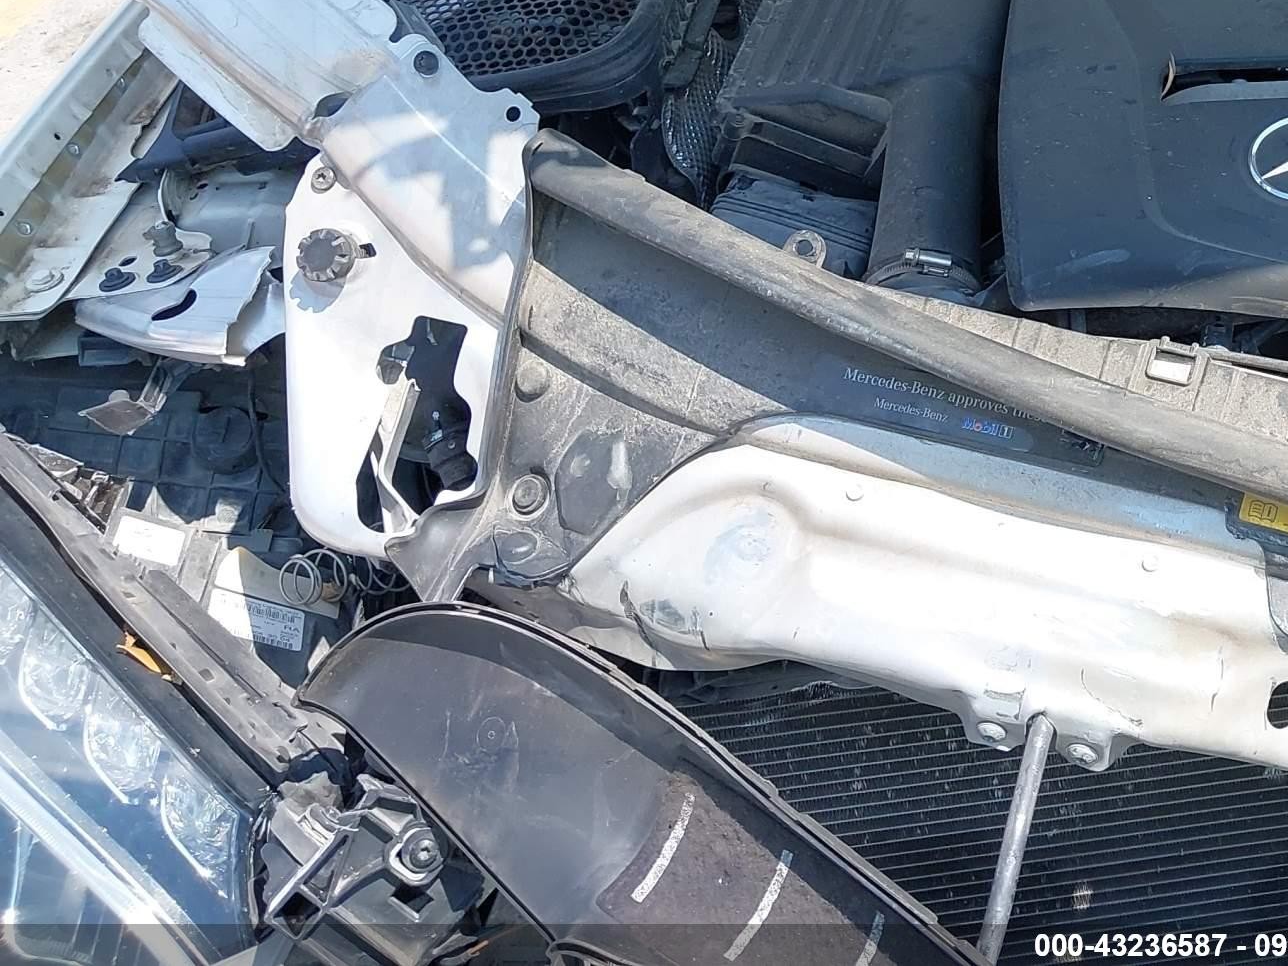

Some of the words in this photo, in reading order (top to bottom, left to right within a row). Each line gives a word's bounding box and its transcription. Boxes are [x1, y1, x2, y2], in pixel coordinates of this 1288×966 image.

[843, 367, 945, 401] Mercedes-Benz
[947, 391, 1010, 415] approves
[873, 397, 949, 423] Mercedes-Benz
[961, 417, 999, 436] Mobil
